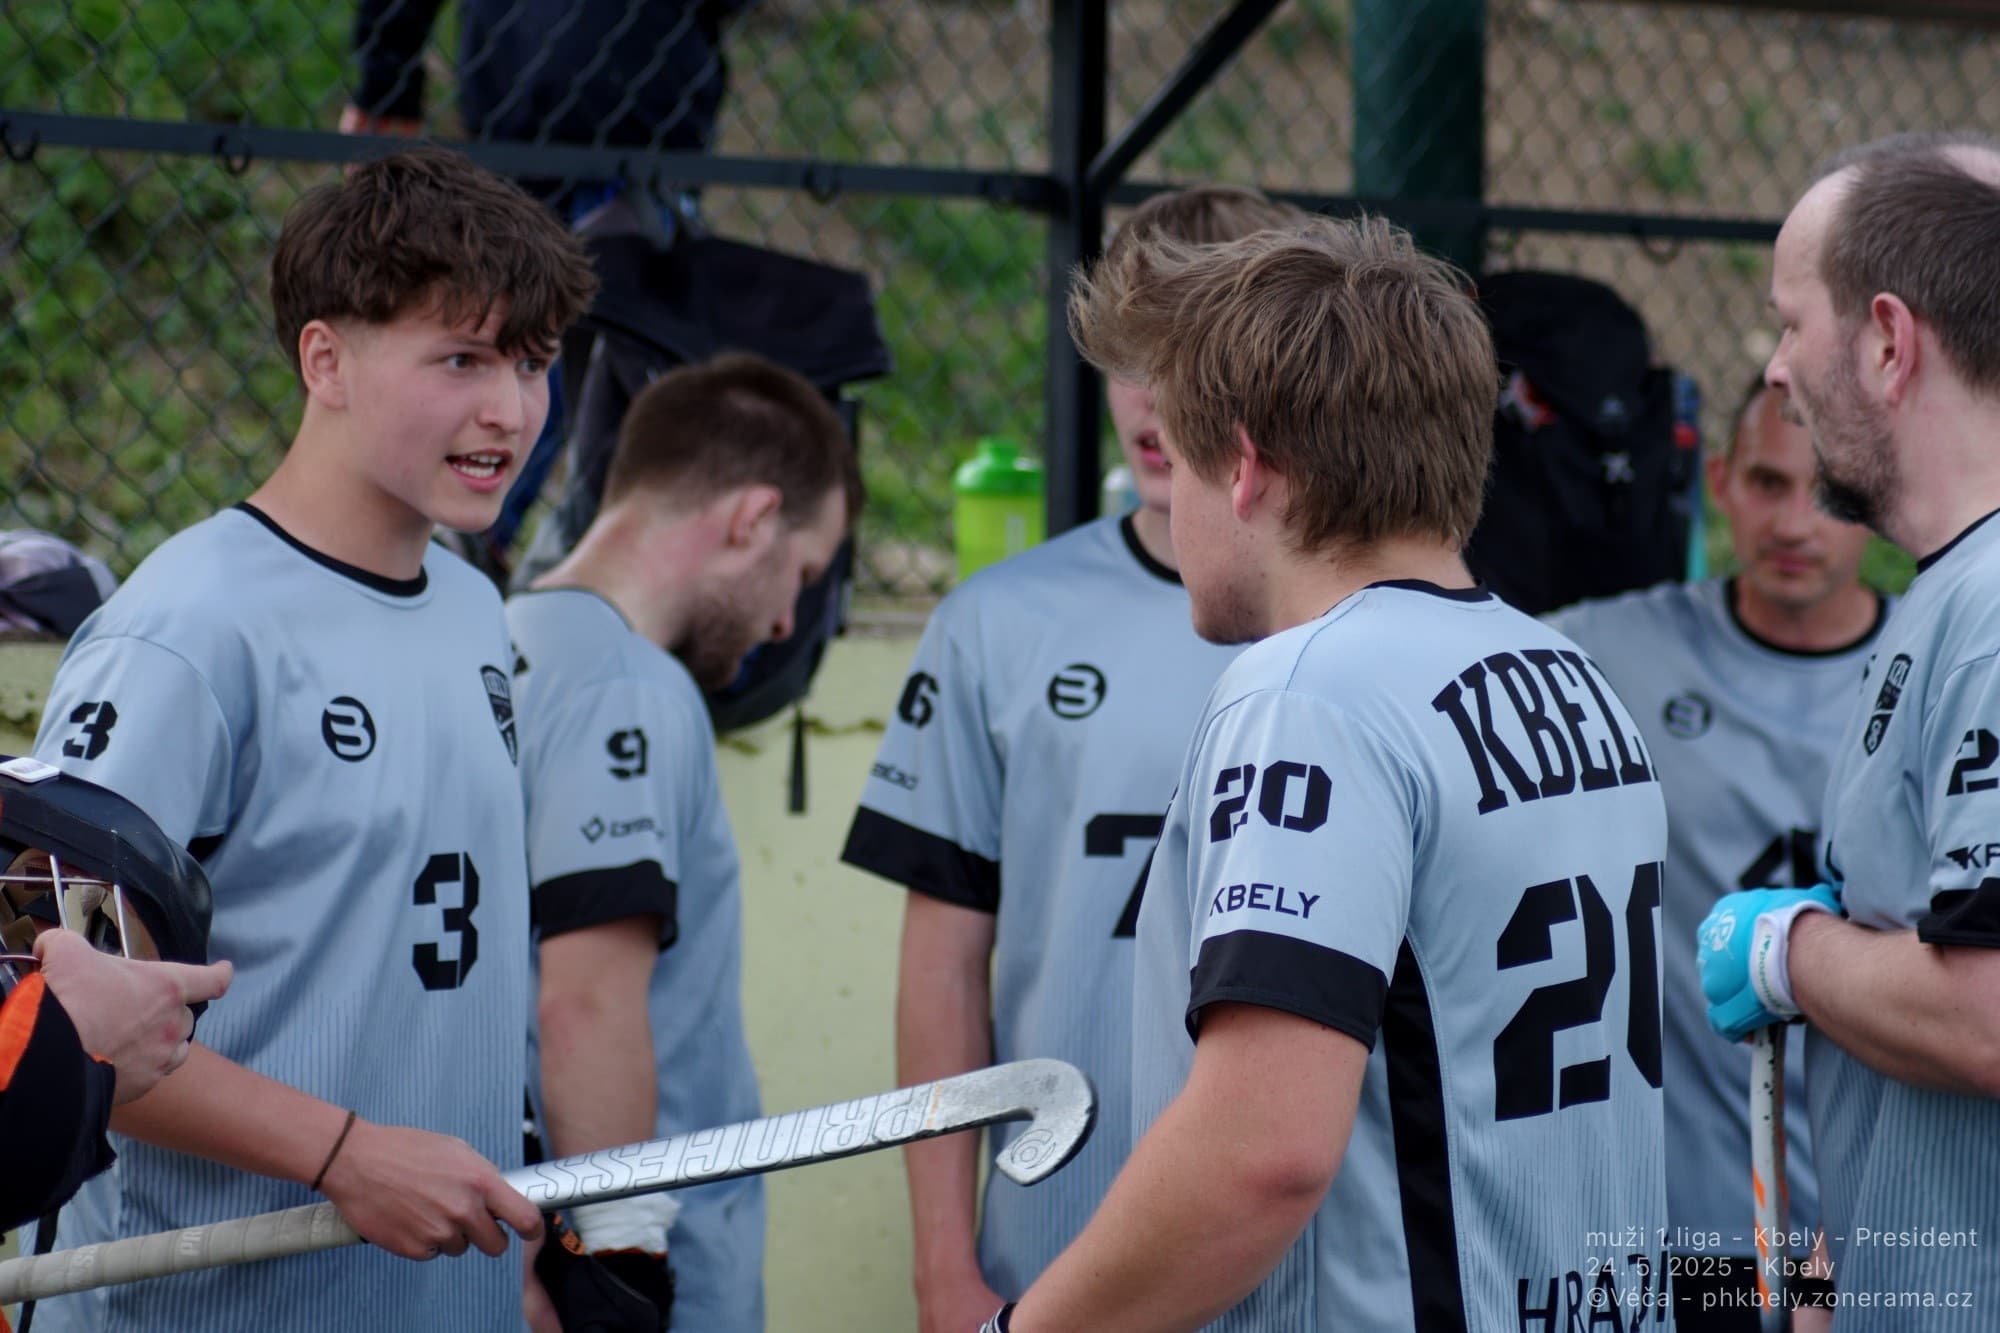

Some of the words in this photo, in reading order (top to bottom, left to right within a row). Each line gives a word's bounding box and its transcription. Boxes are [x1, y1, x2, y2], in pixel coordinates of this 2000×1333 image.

[898, 671, 939, 729] 6
[62, 701, 118, 761] 3
[607, 728, 648, 781] 9
[1431, 649, 1660, 816] KBEL
[1210, 760, 1333, 844] 20
[412, 852, 480, 991] 3
[1209, 883, 1321, 919] KBELY
